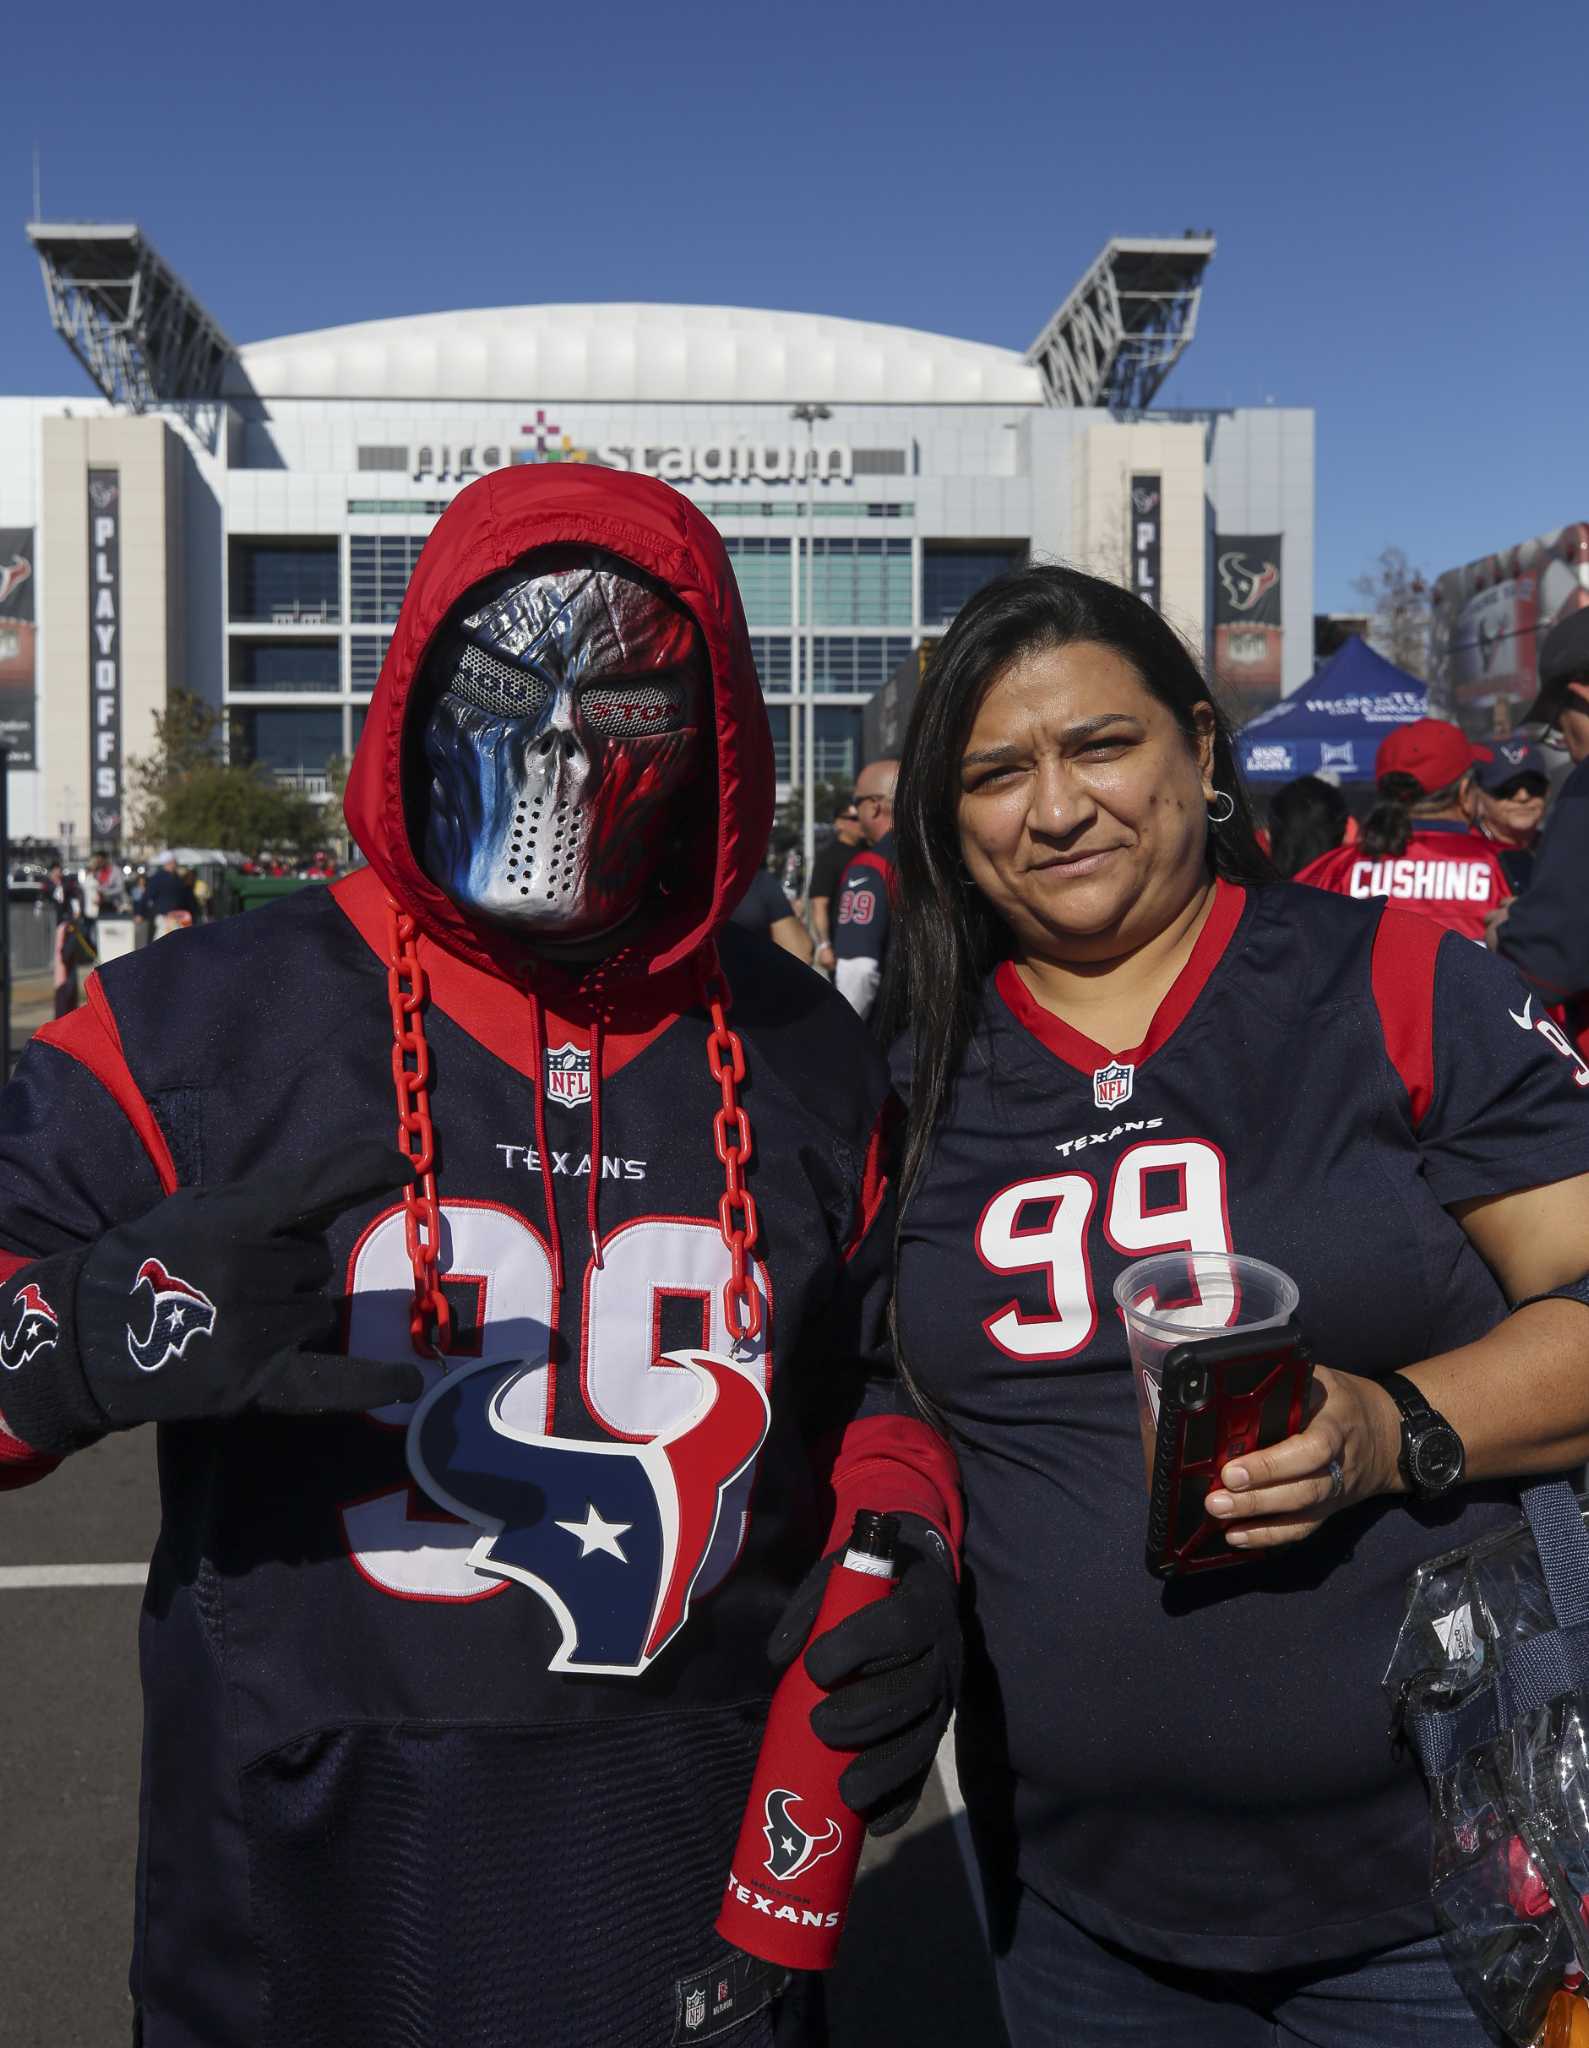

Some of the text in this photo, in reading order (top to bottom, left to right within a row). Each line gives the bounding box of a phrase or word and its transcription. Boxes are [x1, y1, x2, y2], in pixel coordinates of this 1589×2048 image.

[596, 428, 853, 478] stadium
[94, 516, 116, 798] PLAYOFFS
[1350, 859, 1492, 901] CUSHING
[551, 1071, 589, 1097] NFL
[1098, 1079, 1125, 1101] NFL
[1055, 1118, 1164, 1157] TEXANS
[496, 1143, 647, 1180] TEXANS
[974, 1136, 1242, 1363] 99
[728, 1871, 840, 1927] TEXANS
